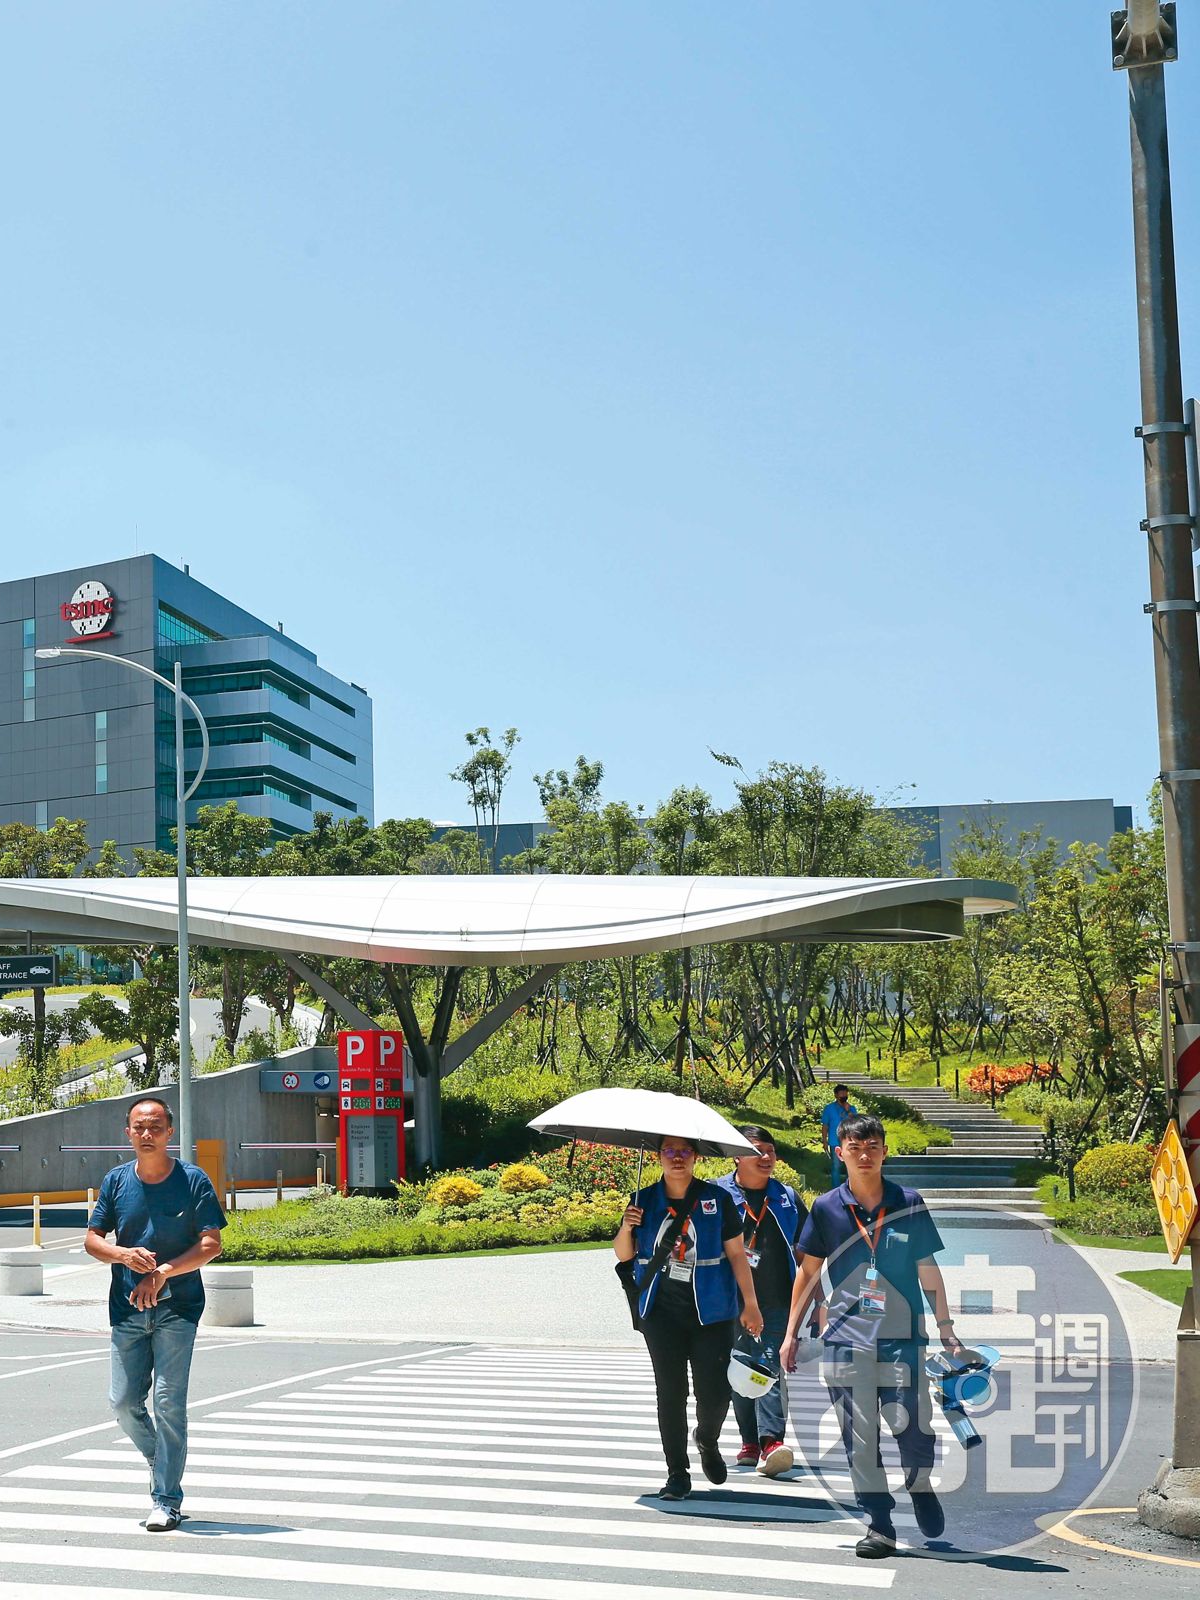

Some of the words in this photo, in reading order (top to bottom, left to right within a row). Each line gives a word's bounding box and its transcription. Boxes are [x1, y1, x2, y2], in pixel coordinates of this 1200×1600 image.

[60, 597, 113, 621] tsmc
[346, 1035, 365, 1066] P
[379, 1035, 396, 1066] P
